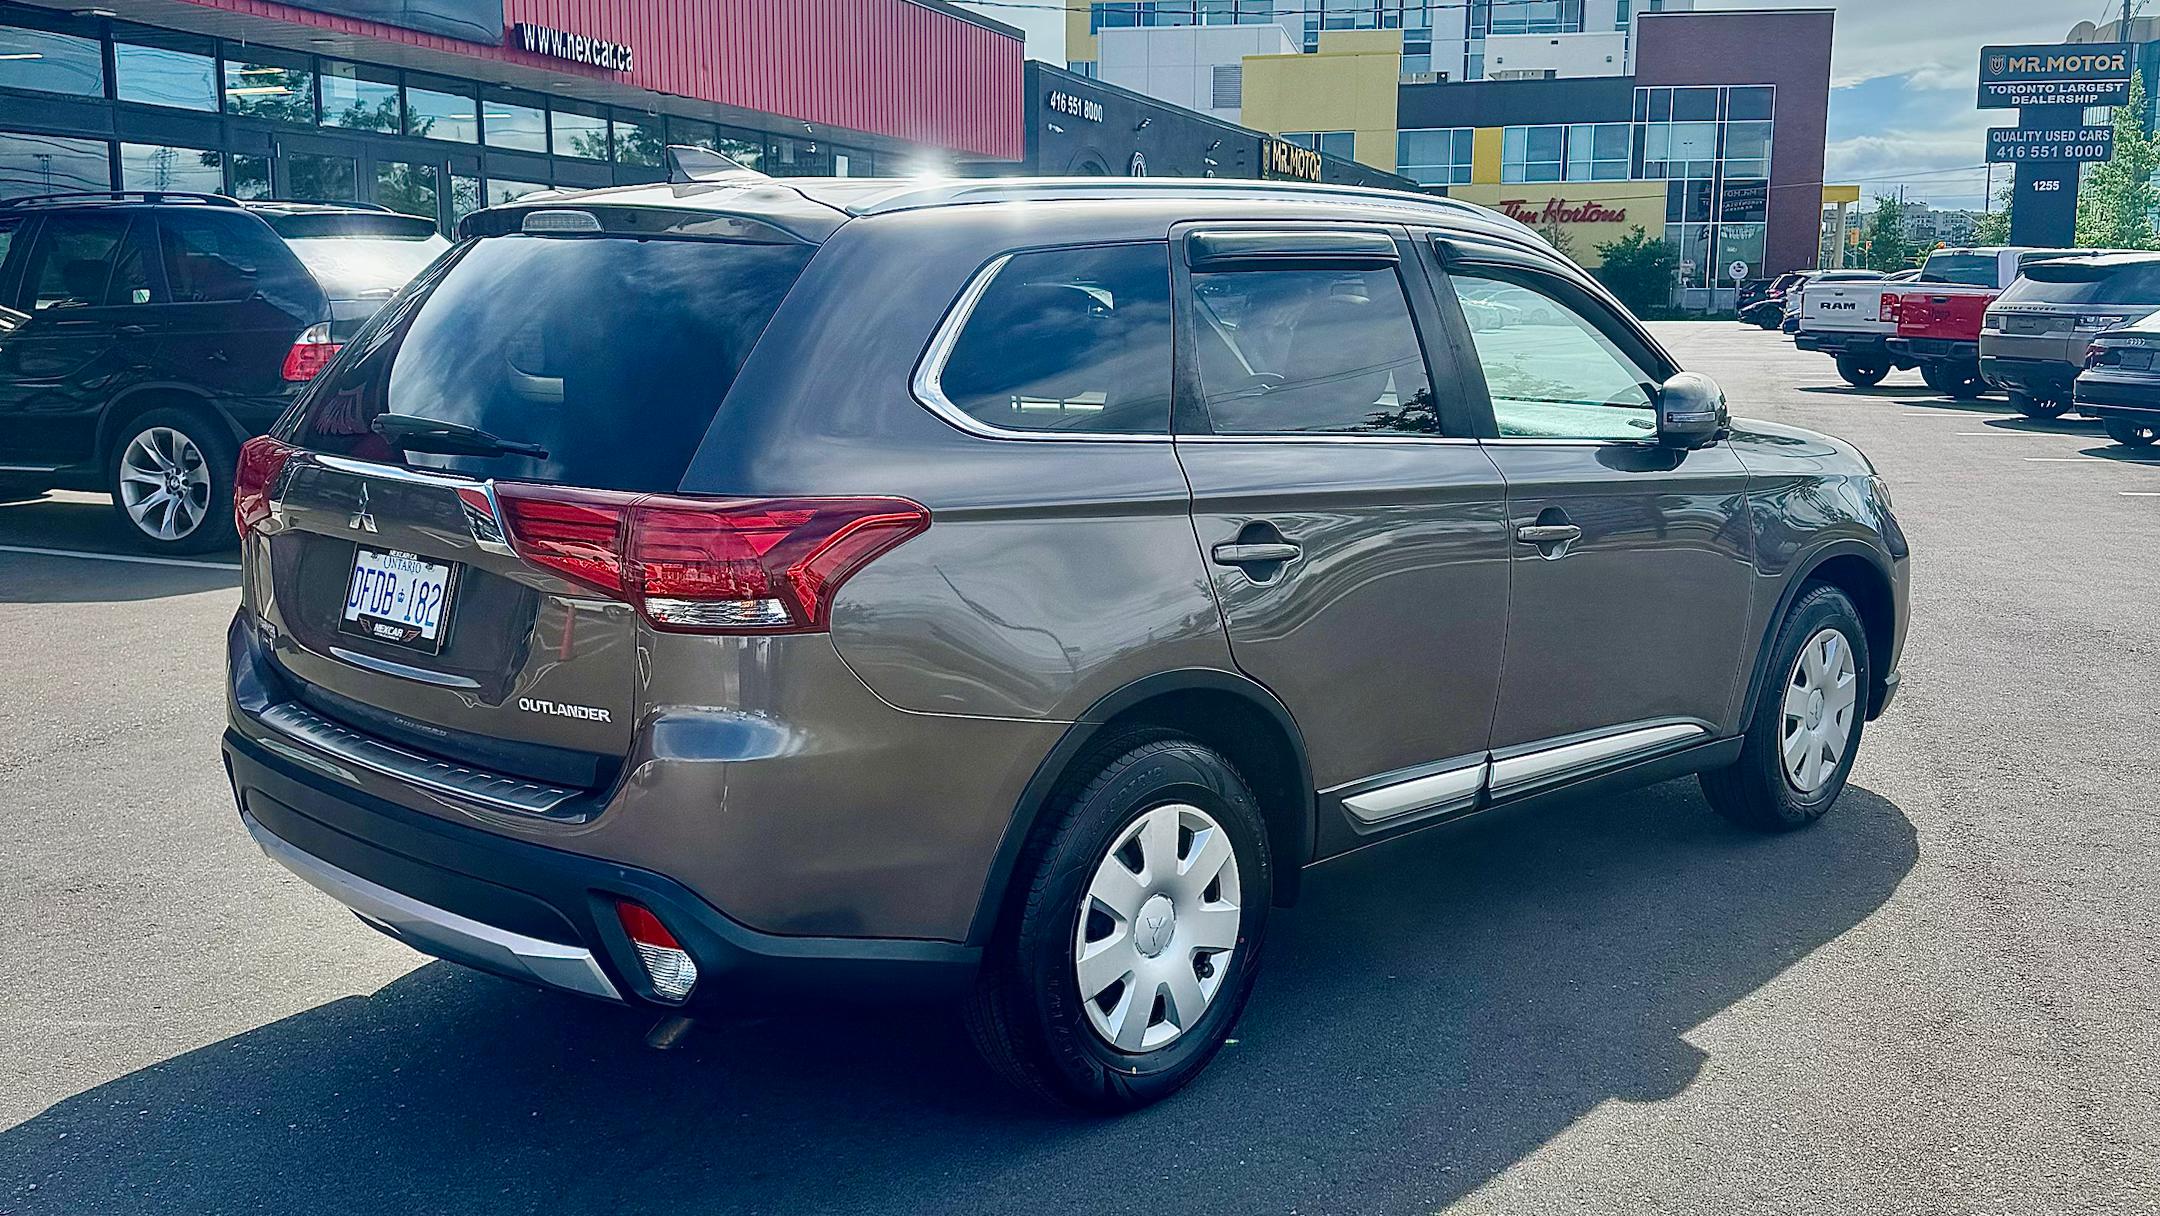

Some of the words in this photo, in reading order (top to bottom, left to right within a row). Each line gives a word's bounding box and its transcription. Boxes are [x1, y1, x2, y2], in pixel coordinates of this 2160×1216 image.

[522, 22, 634, 73] www.nexcar.ca
[2008, 55, 2125, 73] MR.MOTOR
[1988, 84, 2055, 94] TORONTO
[2059, 83, 2123, 93] LARGEST
[1050, 90, 1067, 112] 416
[1068, 95, 1082, 117] 551
[1084, 99, 1103, 123] 8000
[2011, 95, 2098, 105] DEALERSHIP
[1992, 131, 2042, 143] QUALITY
[2045, 131, 2076, 141] USED
[2079, 130, 2110, 141] CARS
[1996, 146, 2025, 158] 416
[2030, 145, 2058, 158] 551
[2064, 145, 2104, 158] 8000
[1272, 141, 1322, 182] MR.MOTOR
[2032, 181, 2060, 191] 1255
[1500, 199, 1538, 223] Tim
[1541, 197, 1627, 223] Hortons
[1820, 302, 1856, 310] RAM
[383, 556, 422, 574] ONTARIO
[348, 566, 397, 616] DFDB
[403, 578, 442, 627] 182
[373, 623, 404, 638] NEXCAR
[519, 697, 612, 723] OUTLANDER
